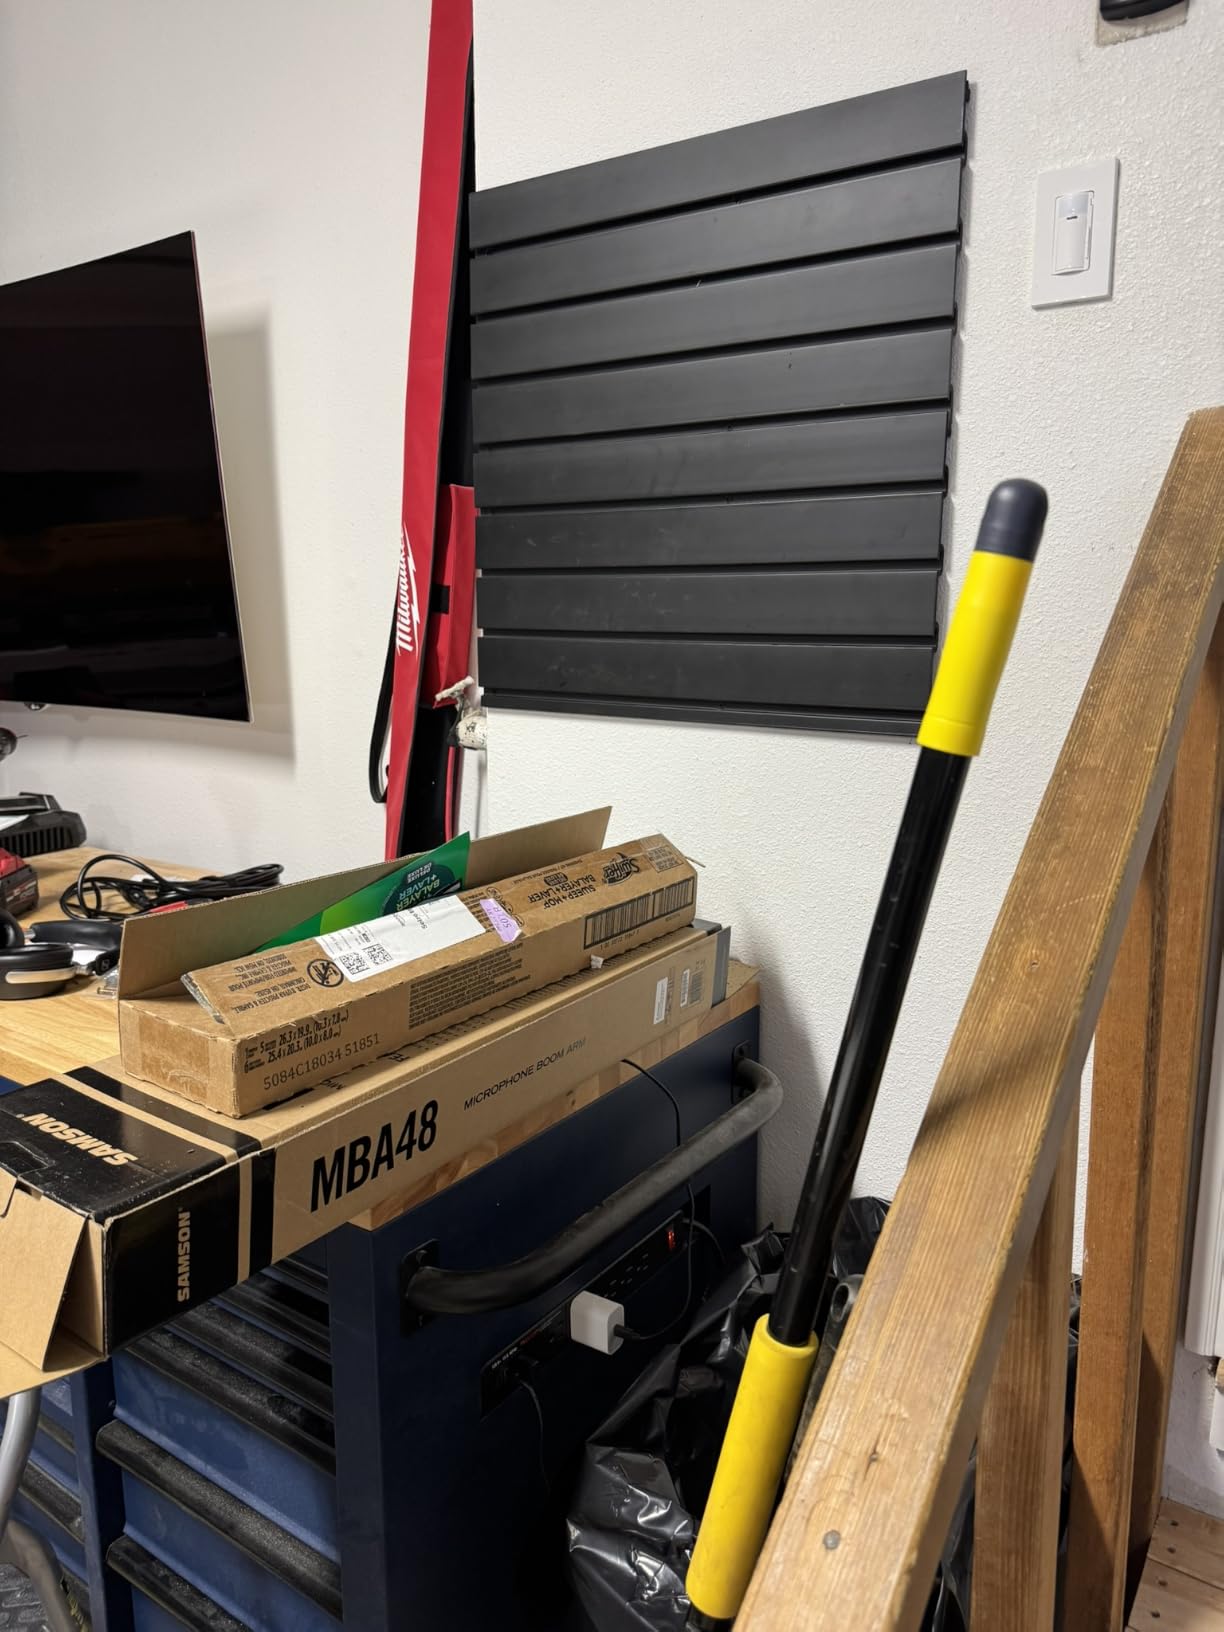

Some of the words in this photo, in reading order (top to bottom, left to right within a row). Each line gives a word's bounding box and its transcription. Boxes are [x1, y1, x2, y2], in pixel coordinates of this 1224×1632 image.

[396, 879, 439, 911] BALAYER
[602, 853, 640, 882] Swiffer
[263, 1048, 342, 1091] 5084C18034
[345, 1032, 381, 1057] 51851
[465, 1065, 535, 1111] MICROPHONE
[537, 1047, 564, 1071] BOOM
[568, 1036, 586, 1055] ARM
[22, 1113, 138, 1166] SAMSON
[310, 1099, 438, 1213] MBA48
[177, 1211, 191, 1302] SAMSON
